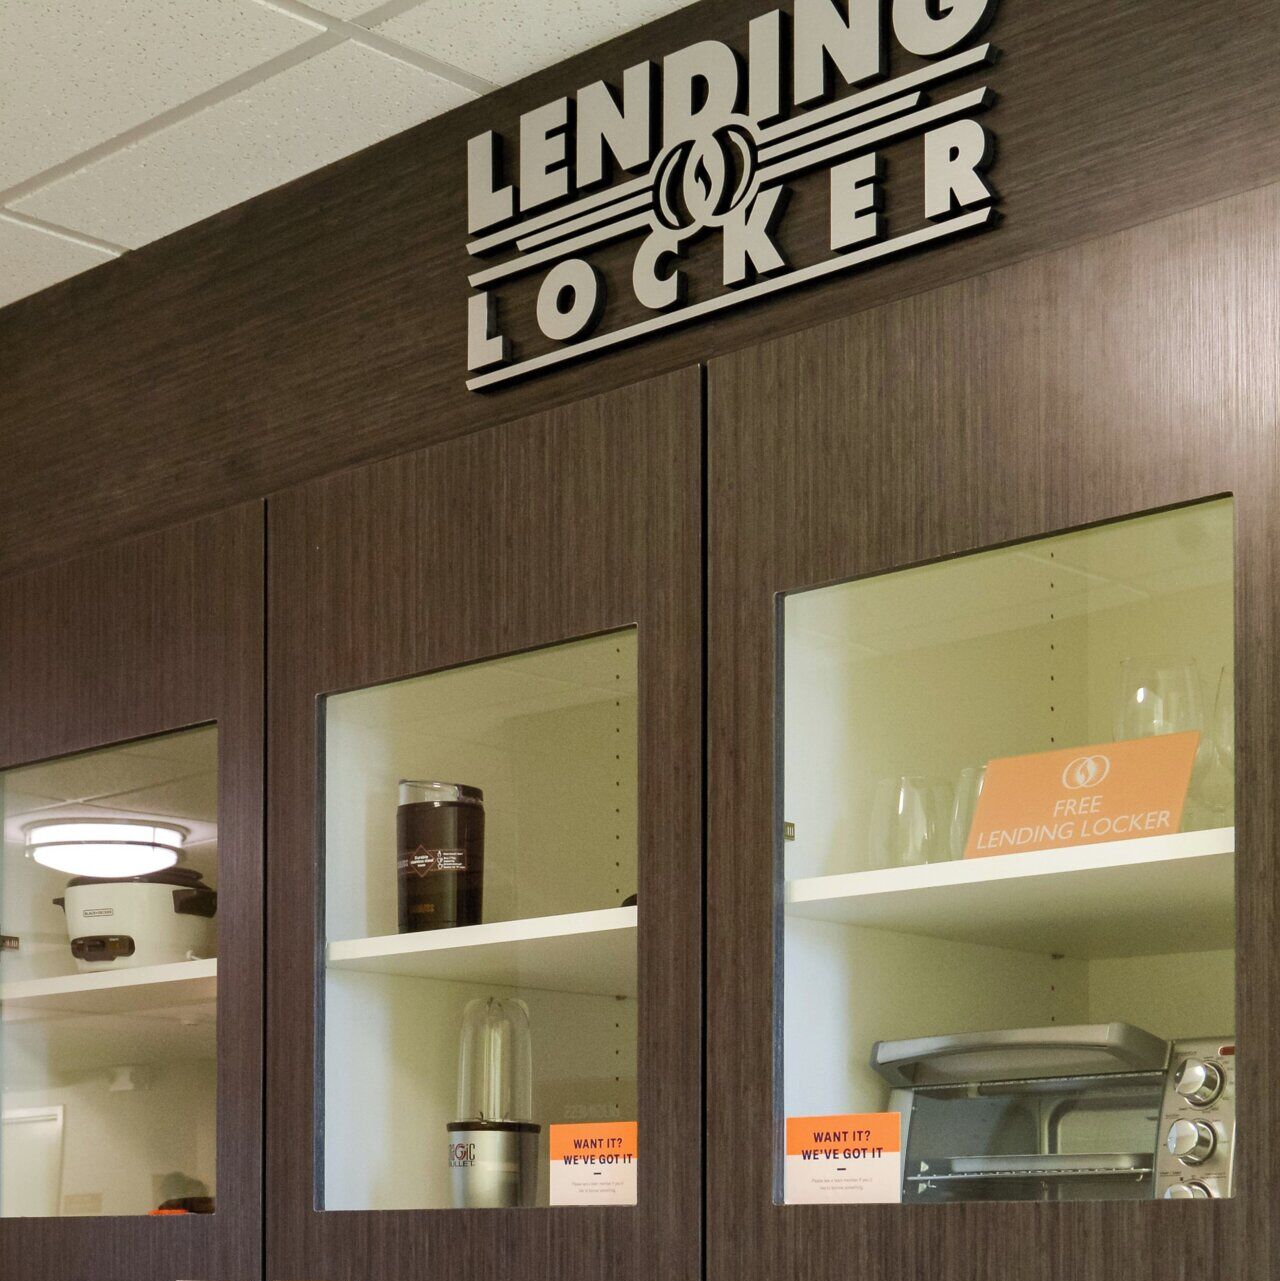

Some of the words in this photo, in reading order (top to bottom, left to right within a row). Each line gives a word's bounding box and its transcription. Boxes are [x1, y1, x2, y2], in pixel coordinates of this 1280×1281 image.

[468, 0, 991, 235] LENDING
[468, 119, 992, 372] LOCKER
[1052, 794, 1104, 818] FREE
[976, 822, 1074, 850] LENDING
[1080, 810, 1170, 838] LOCKER
[573, 1138, 604, 1149] WANT
[607, 1137, 623, 1148] IT?
[813, 1131, 849, 1143] WANT
[852, 1130, 871, 1142] IT?
[563, 1154, 596, 1166] WE'VE
[598, 1153, 620, 1165] GOT
[623, 1153, 633, 1164] IT
[801, 1148, 840, 1161] WE'VE
[843, 1148, 868, 1159] GOT
[872, 1147, 884, 1159] IT
